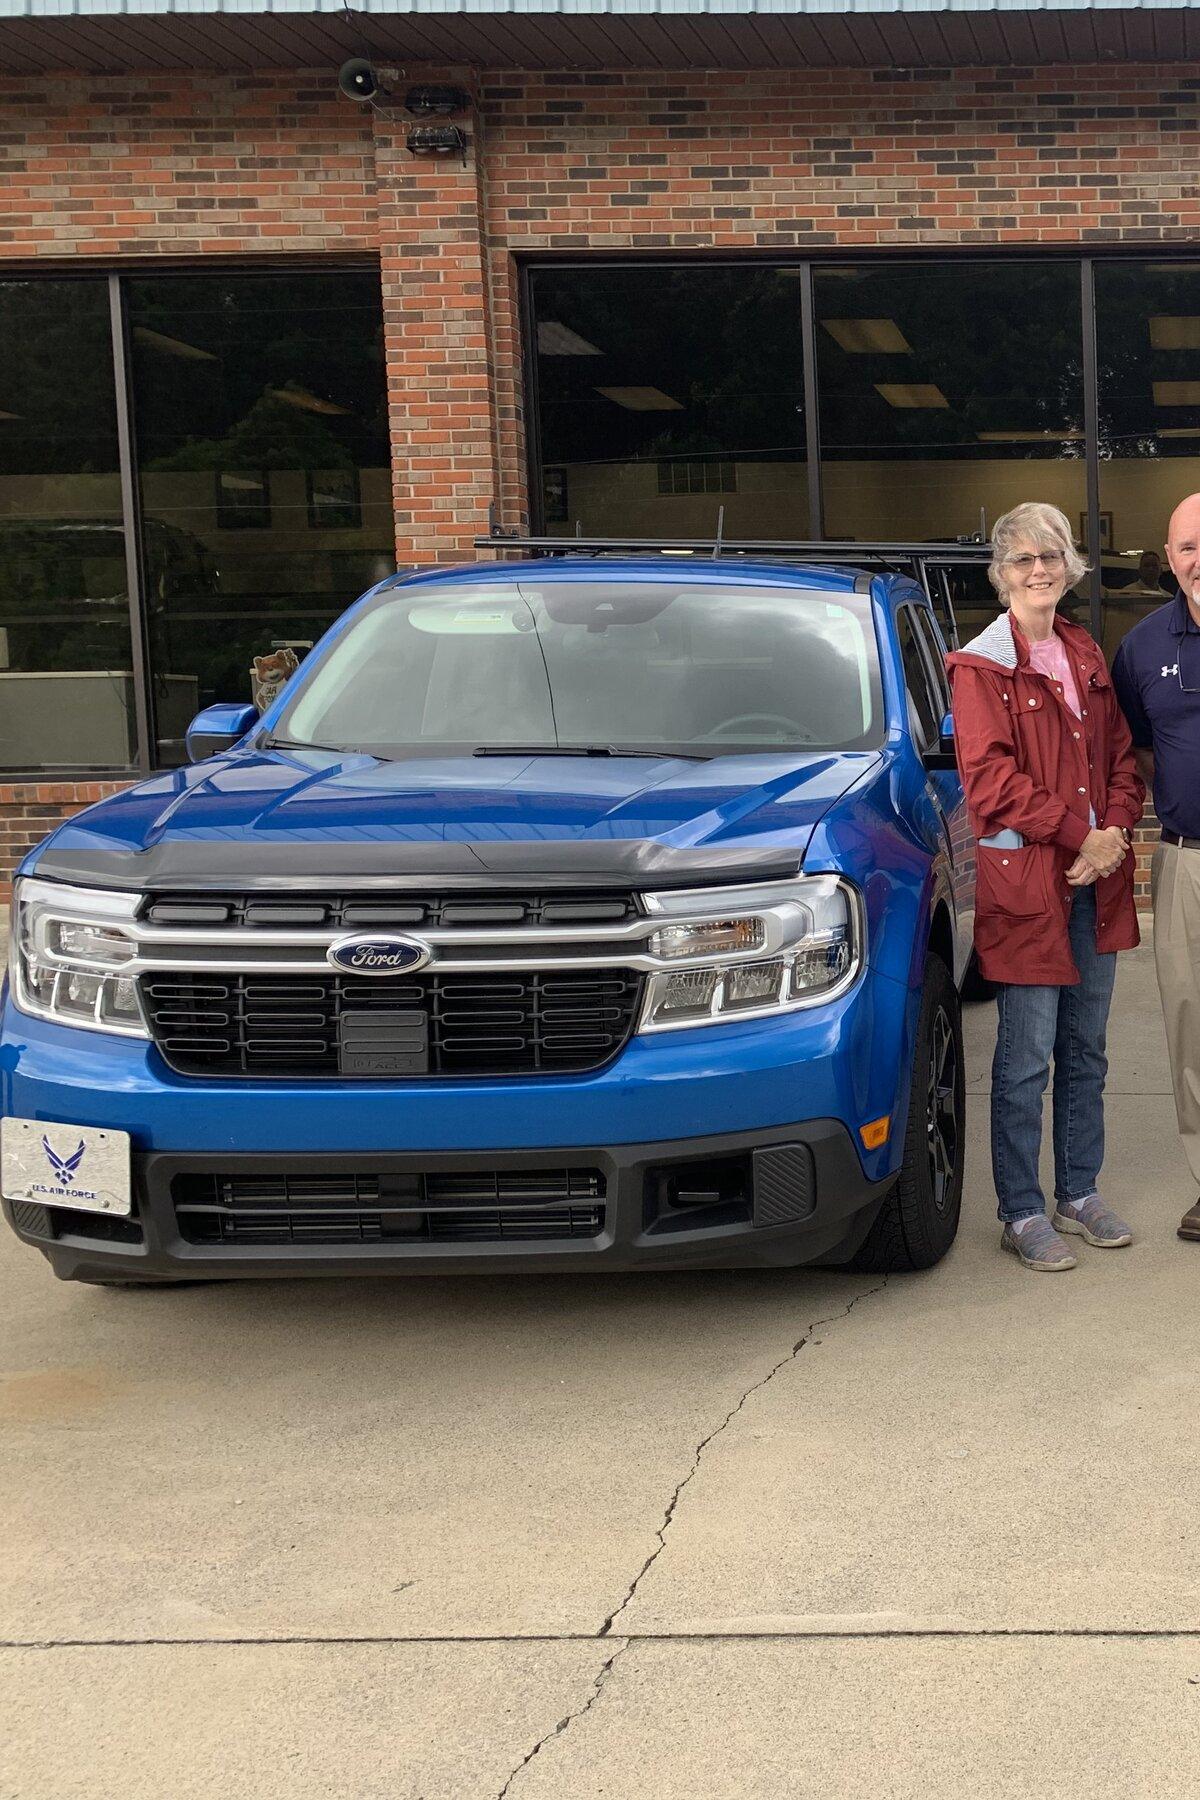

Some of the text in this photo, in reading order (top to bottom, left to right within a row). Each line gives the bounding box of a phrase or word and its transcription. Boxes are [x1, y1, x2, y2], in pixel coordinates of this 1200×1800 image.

[351, 944, 403, 966] Ford
[32, 1184, 97, 1200] U.S. AIR FORCE
